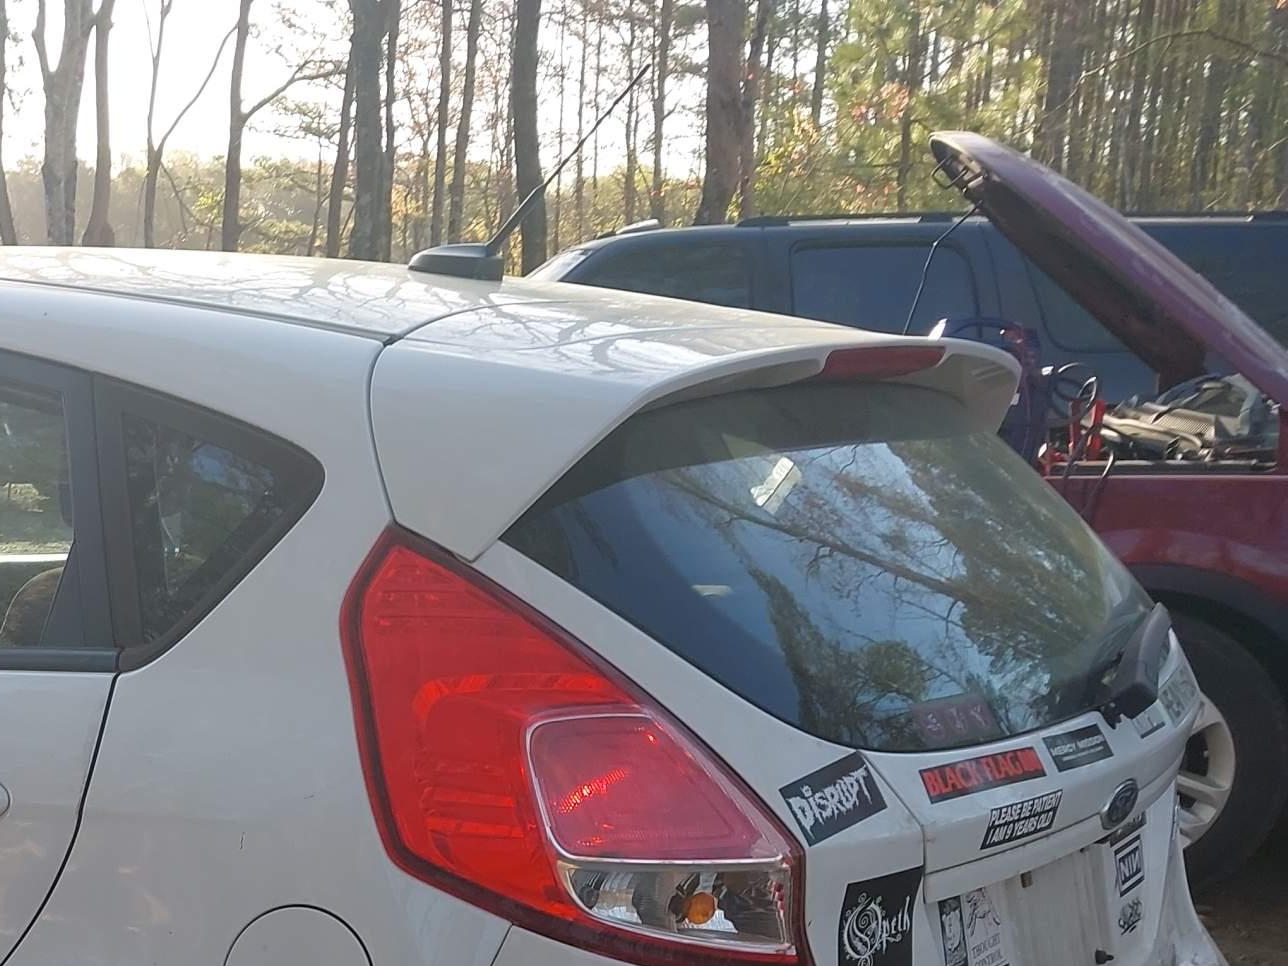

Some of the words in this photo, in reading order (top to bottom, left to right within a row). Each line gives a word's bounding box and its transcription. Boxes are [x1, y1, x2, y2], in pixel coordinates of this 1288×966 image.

[922, 761, 985, 796] BLACK
[982, 751, 1024, 782] FLAG
[990, 803, 1022, 826] PLEASE
[1021, 799, 1034, 818] BE
[1032, 790, 1062, 815] PATIENT
[990, 825, 1007, 843] AM
[1013, 816, 1039, 837] YEARS
[1037, 811, 1054, 829] OLD
